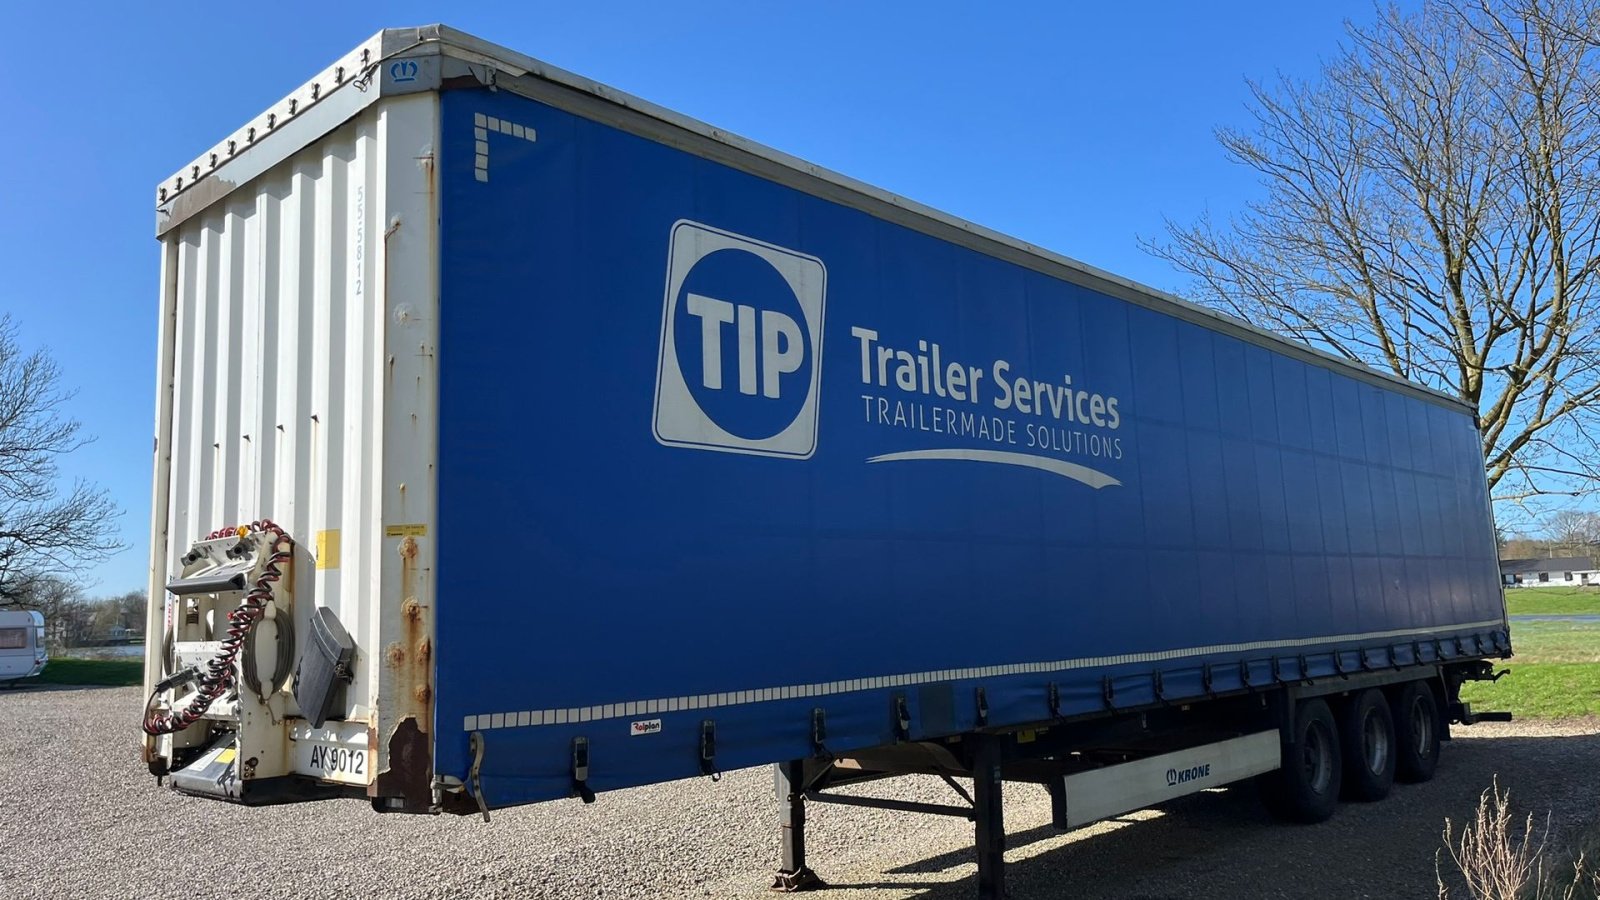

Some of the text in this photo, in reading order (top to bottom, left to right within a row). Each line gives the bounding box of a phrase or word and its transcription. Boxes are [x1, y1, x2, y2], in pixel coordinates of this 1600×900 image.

[686, 293, 805, 399] TIP
[851, 326, 1120, 429] Trailer Services
[861, 395, 1123, 460] TRAILERMADE SOLUTIONS
[310, 745, 364, 775] AY 9012
[1178, 763, 1210, 784] KRONE
